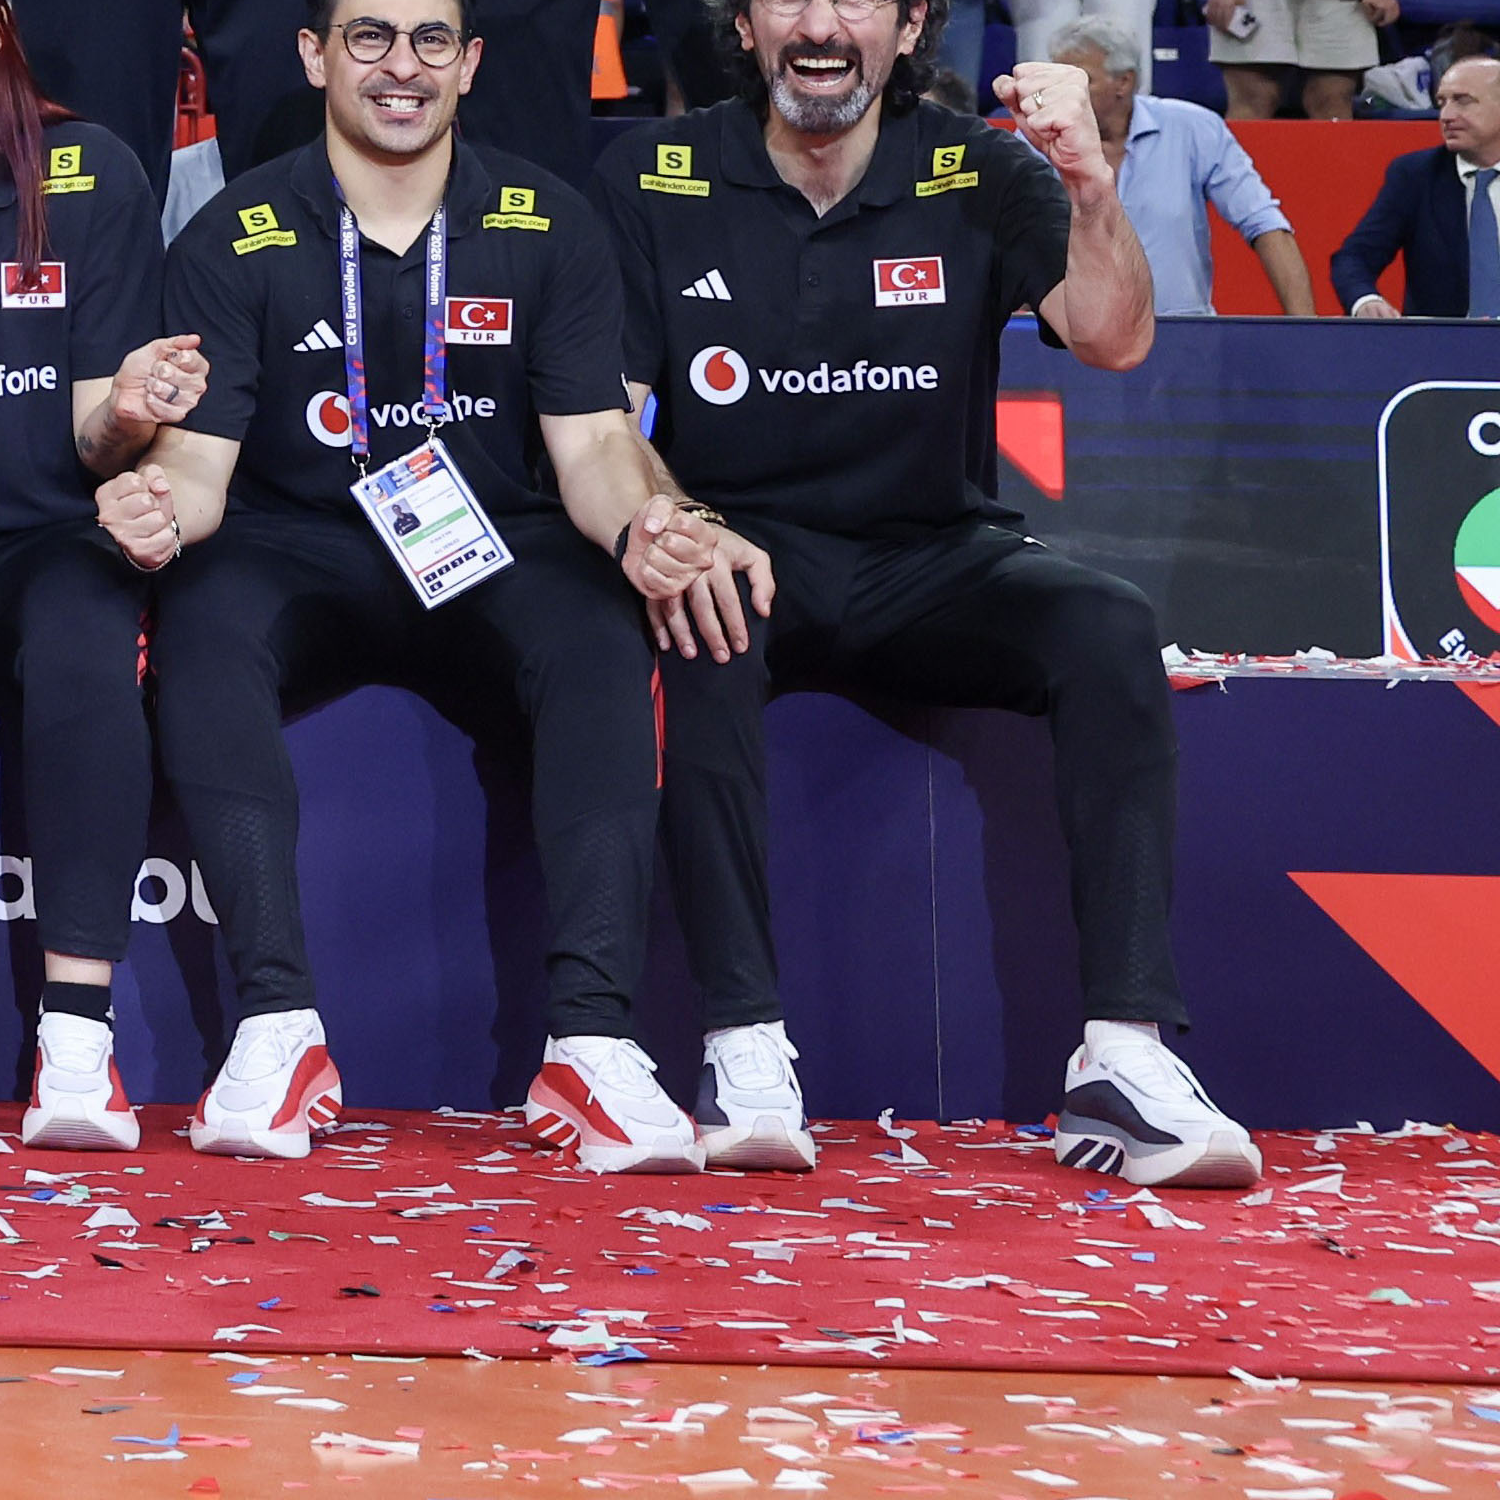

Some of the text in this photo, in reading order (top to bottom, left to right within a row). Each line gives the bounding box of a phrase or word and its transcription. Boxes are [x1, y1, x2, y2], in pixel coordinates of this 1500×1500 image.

[54, 147, 73, 169] S
[666, 149, 684, 171] S
[940, 151, 956, 170] S
[641, 179, 708, 194] sahibinden.com
[509, 191, 525, 211] S
[248, 209, 266, 230] S
[343, 260, 357, 320] EuroVolley
[429, 262, 443, 306] Women
[14, 294, 50, 304] TUR
[892, 292, 930, 303] TUR
[346, 321, 358, 346] CEV
[460, 331, 498, 343] TUR
[759, 361, 939, 395] vodafone
